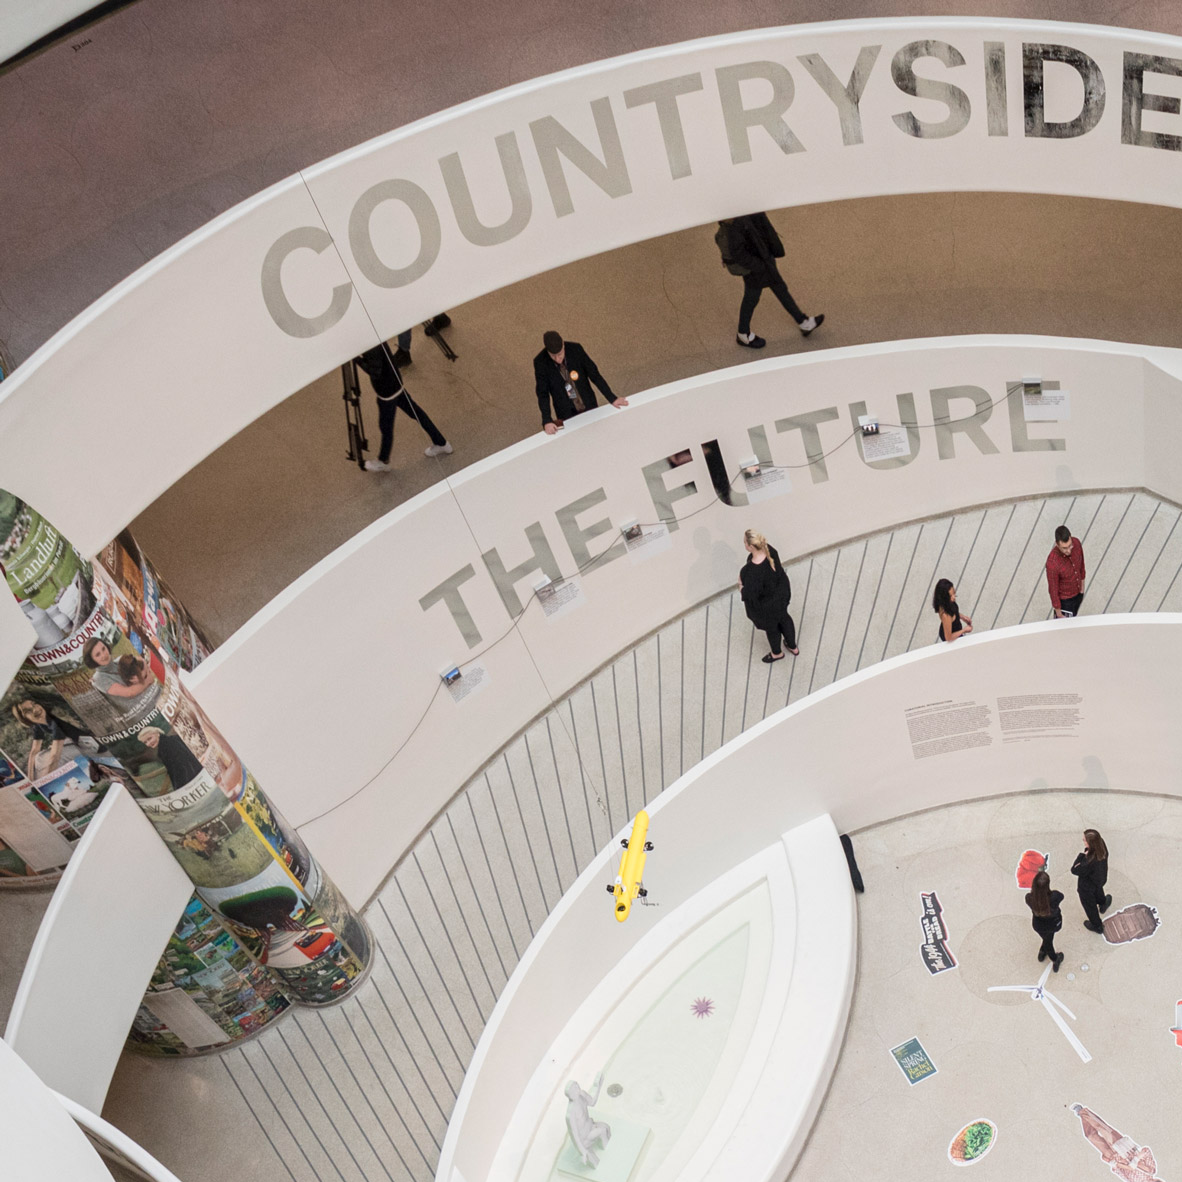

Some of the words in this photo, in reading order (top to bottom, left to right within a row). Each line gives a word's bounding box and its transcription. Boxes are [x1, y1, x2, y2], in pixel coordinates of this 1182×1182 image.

[10, 524, 57, 585] Landluft
[418, 487, 626, 650] THE
[641, 380, 1067, 532] FUTURE
